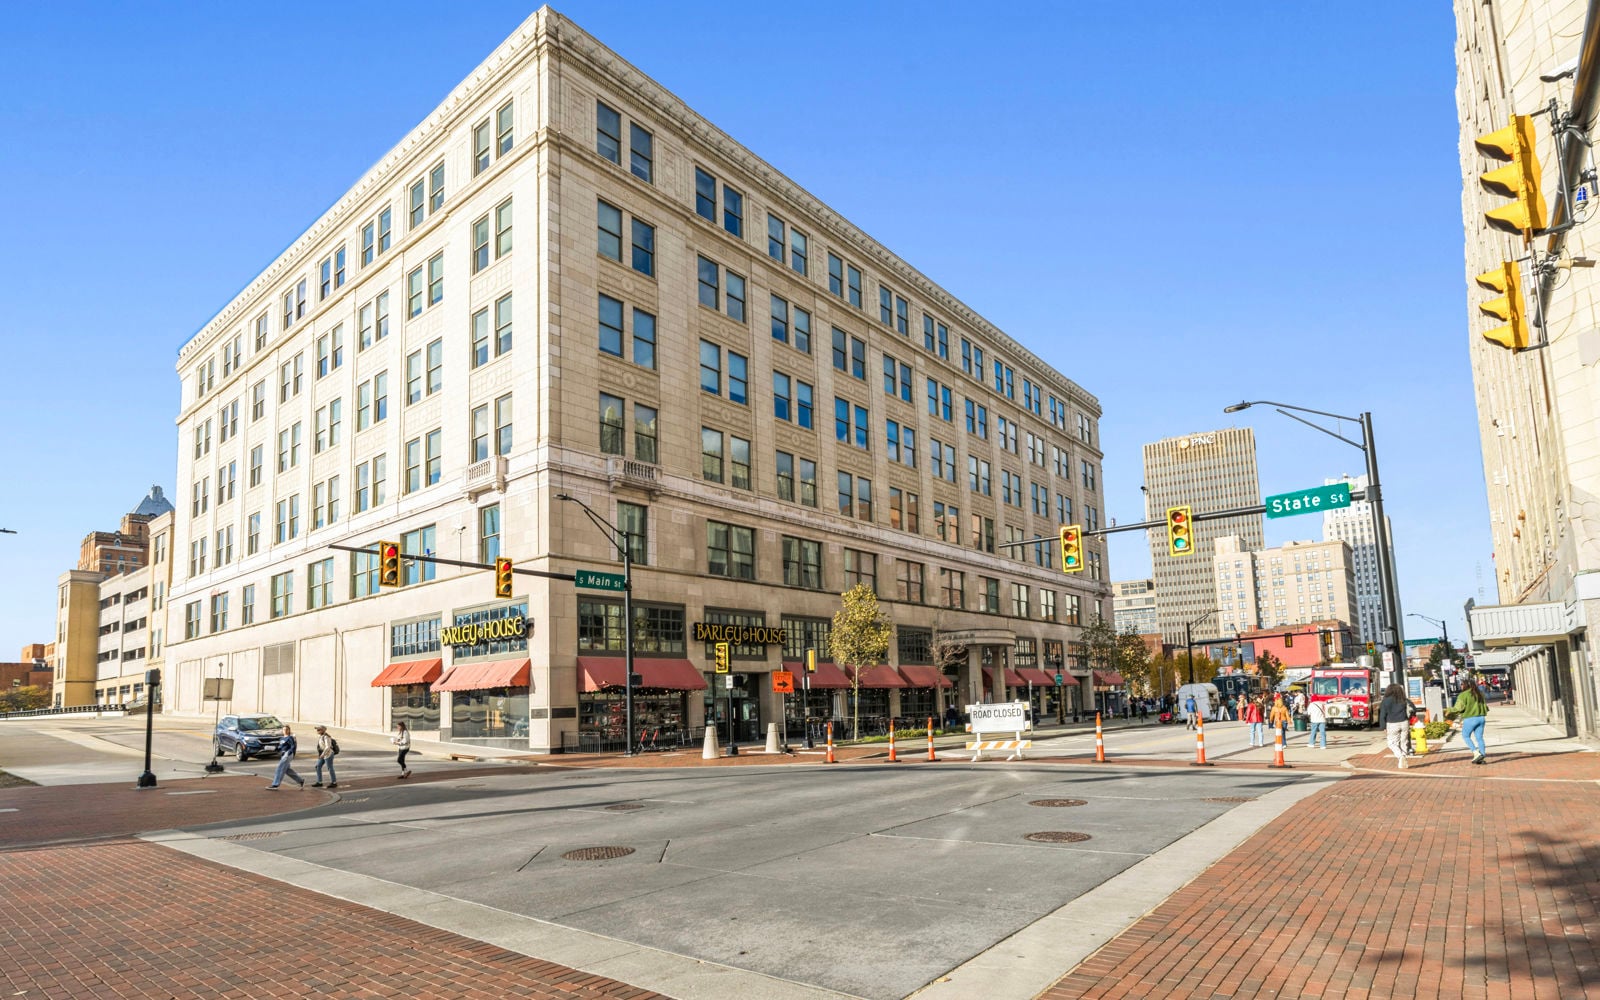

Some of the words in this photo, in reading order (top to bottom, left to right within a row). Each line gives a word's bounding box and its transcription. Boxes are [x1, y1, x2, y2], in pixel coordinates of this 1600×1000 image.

[1191, 435, 1214, 447] PNC
[1272, 495, 1321, 513] State
[1330, 493, 1344, 504] St
[579, 576, 584, 584] S
[587, 575, 611, 587] Main
[614, 580, 621, 588] St
[440, 624, 477, 646] BARLEY
[484, 616, 522, 639] HOUSE
[697, 623, 742, 645] BARLEY
[749, 627, 787, 644] HOUSE
[973, 709, 992, 719] ROAD
[993, 708, 1022, 718] CLOSED
